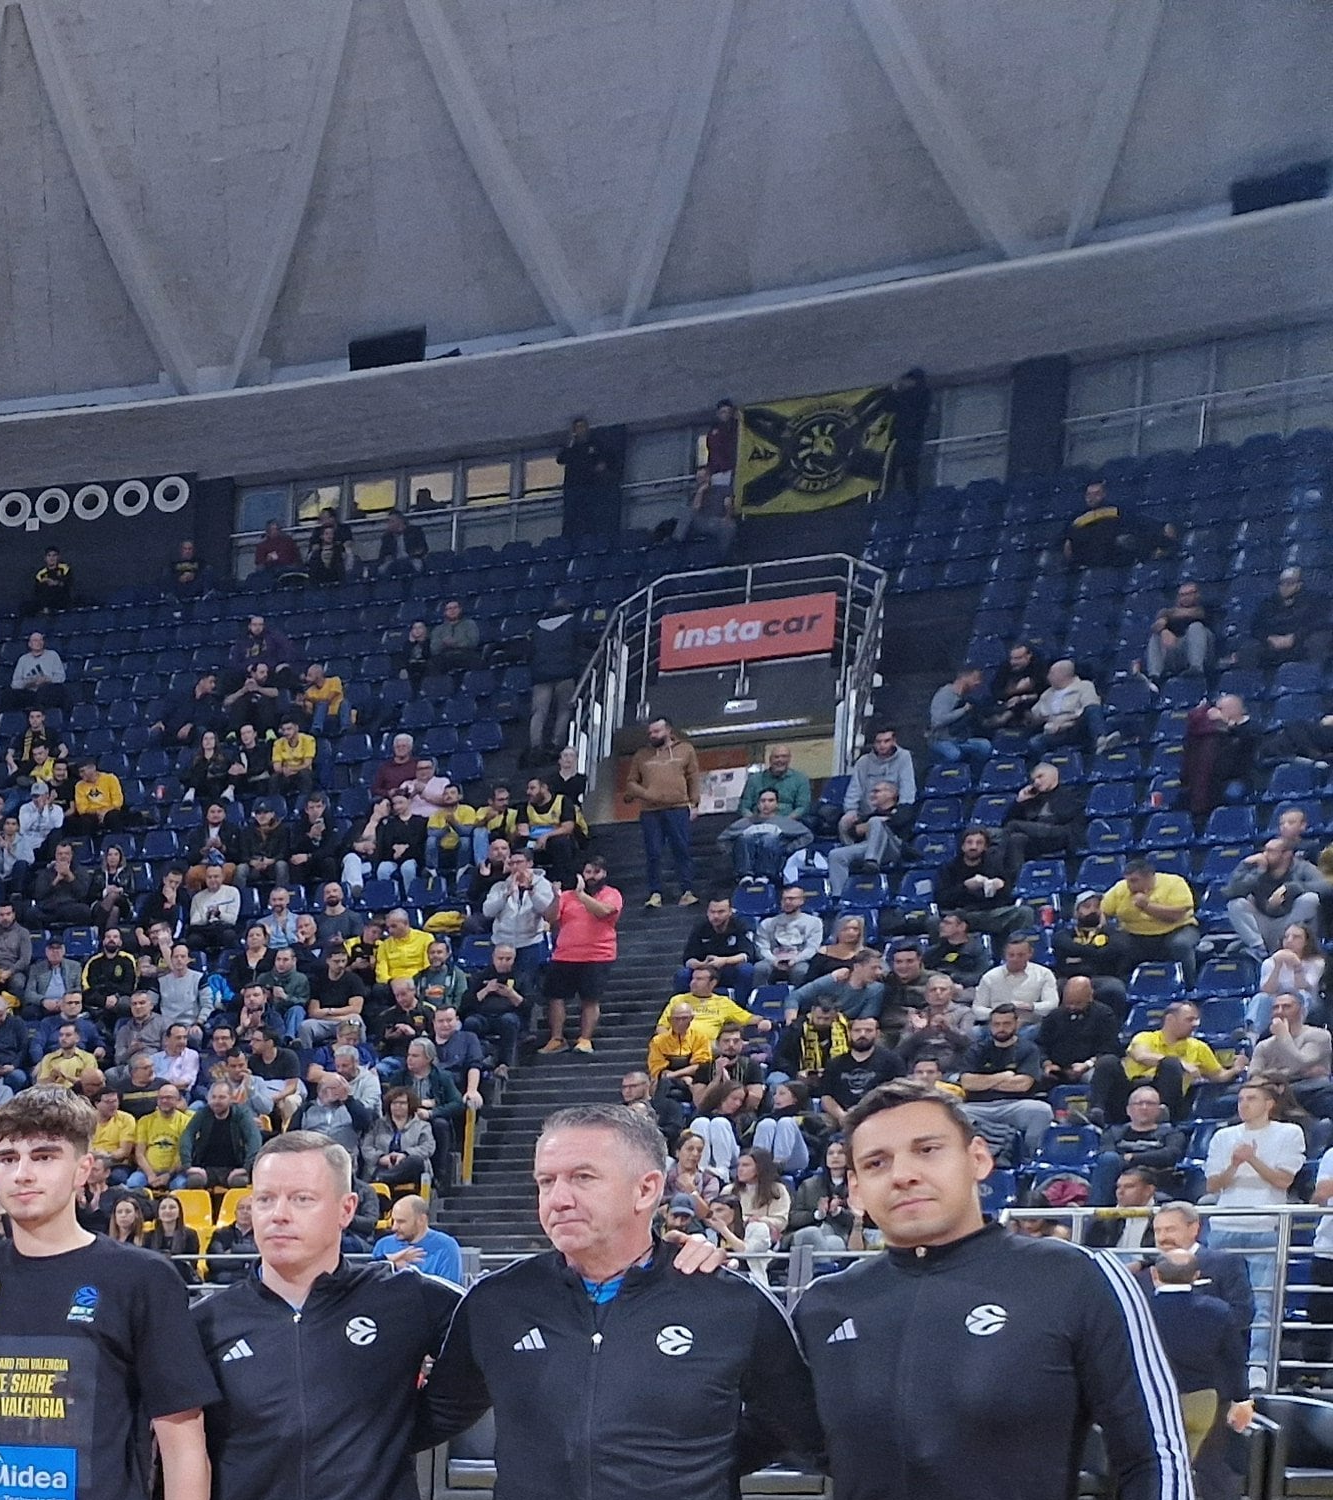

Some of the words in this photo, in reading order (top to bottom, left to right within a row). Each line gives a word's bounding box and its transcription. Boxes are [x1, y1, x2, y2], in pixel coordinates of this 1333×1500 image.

[673, 612, 822, 649] instacar
[16, 1358, 29, 1371] FOR
[31, 1357, 69, 1372] VALENCIA
[10, 1373, 56, 1395] SHARE
[0, 1397, 66, 1419] VALENCIA
